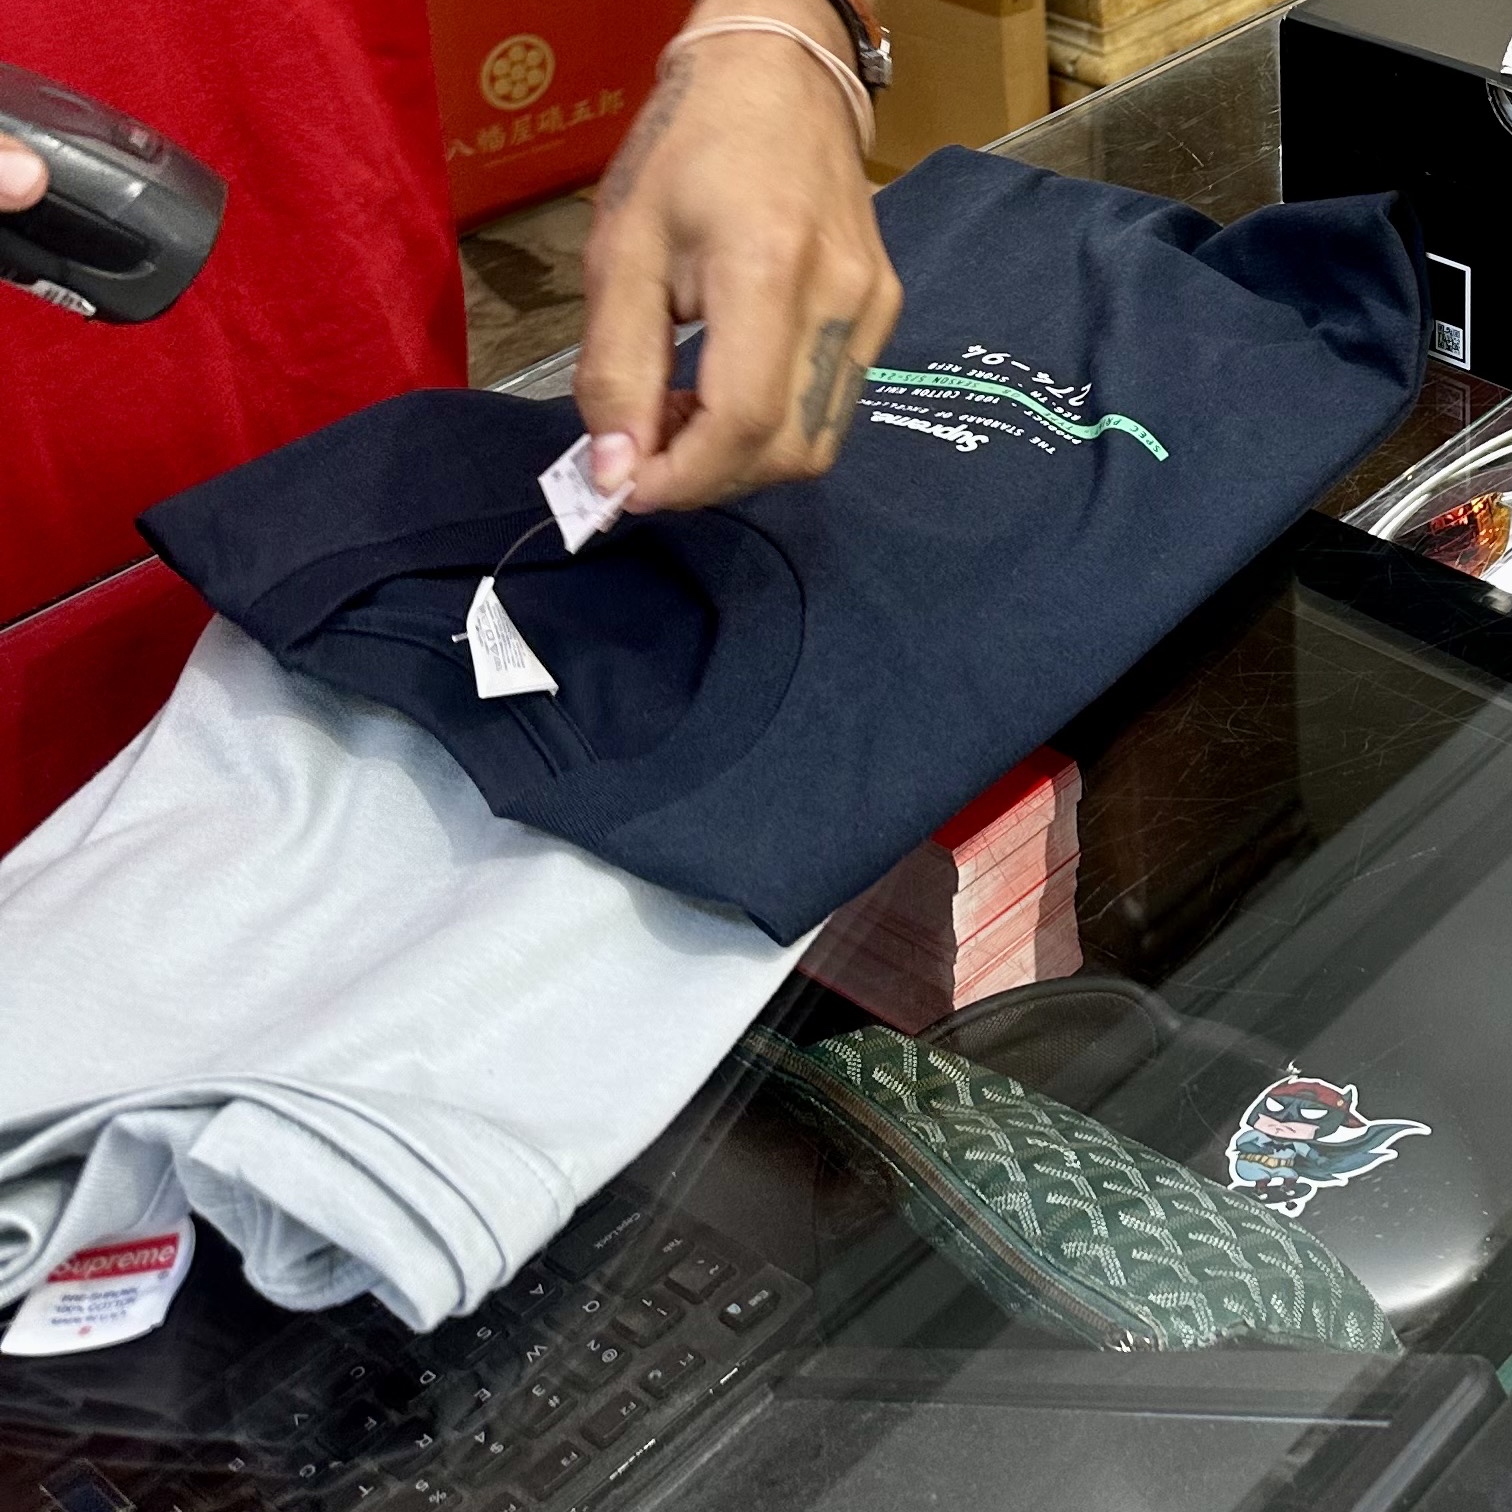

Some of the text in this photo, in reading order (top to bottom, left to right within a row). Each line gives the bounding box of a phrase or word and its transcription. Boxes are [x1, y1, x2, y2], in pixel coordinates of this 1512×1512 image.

[911, 388, 960, 399] COTTON
[958, 414, 1025, 436] STANDARD
[1029, 436, 1056, 455] THE
